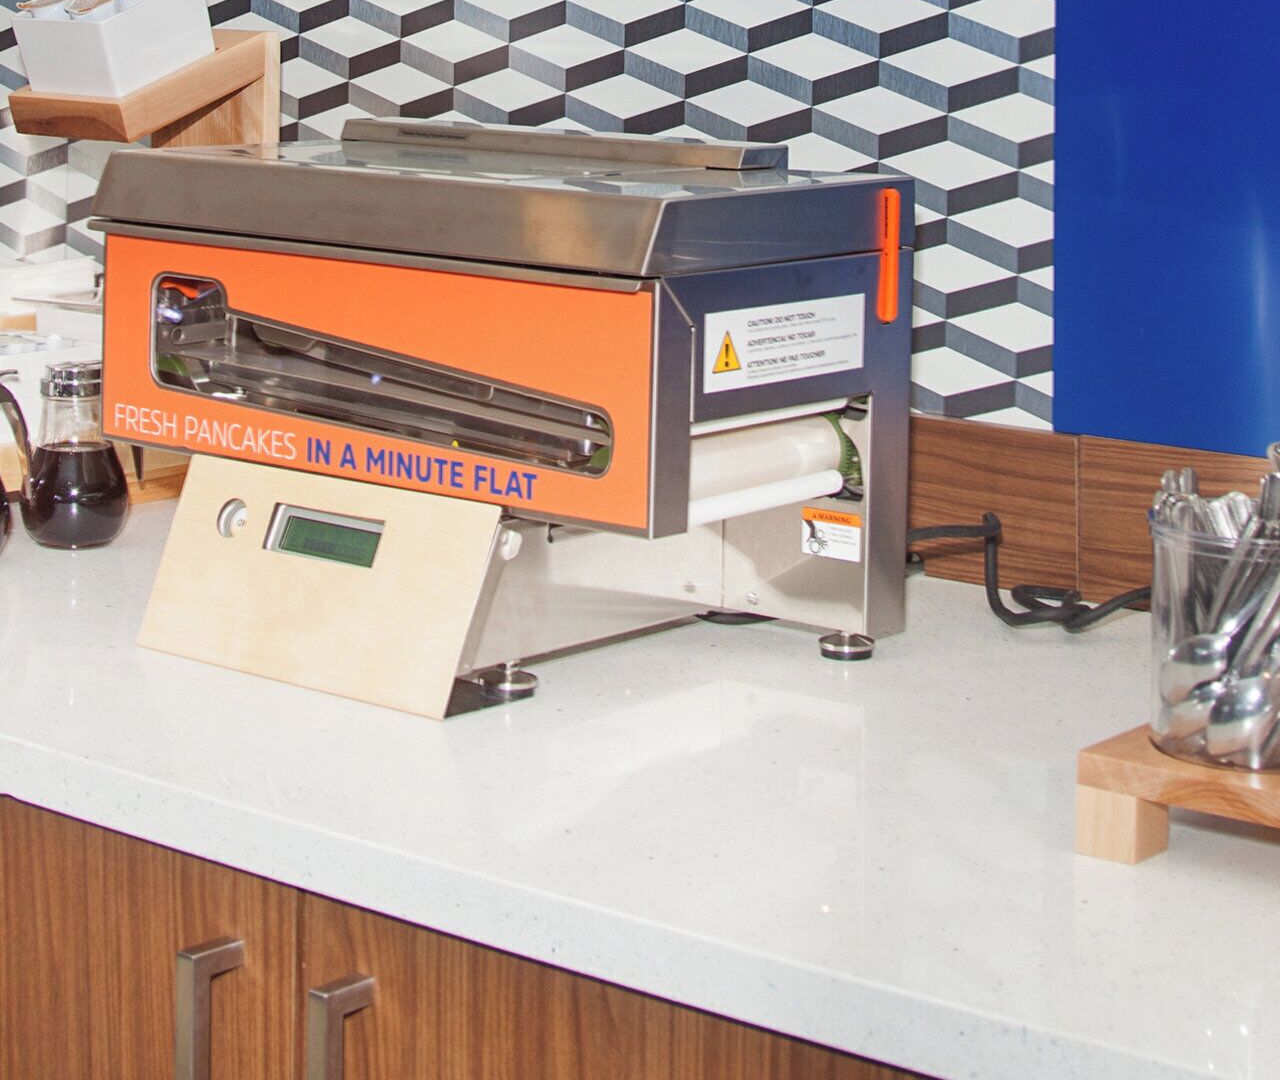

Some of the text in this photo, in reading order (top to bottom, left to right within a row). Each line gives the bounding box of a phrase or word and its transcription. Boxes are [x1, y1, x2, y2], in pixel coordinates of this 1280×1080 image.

[114, 403, 538, 501] FRESH PANCAKES IN A MINUTE FLAT
